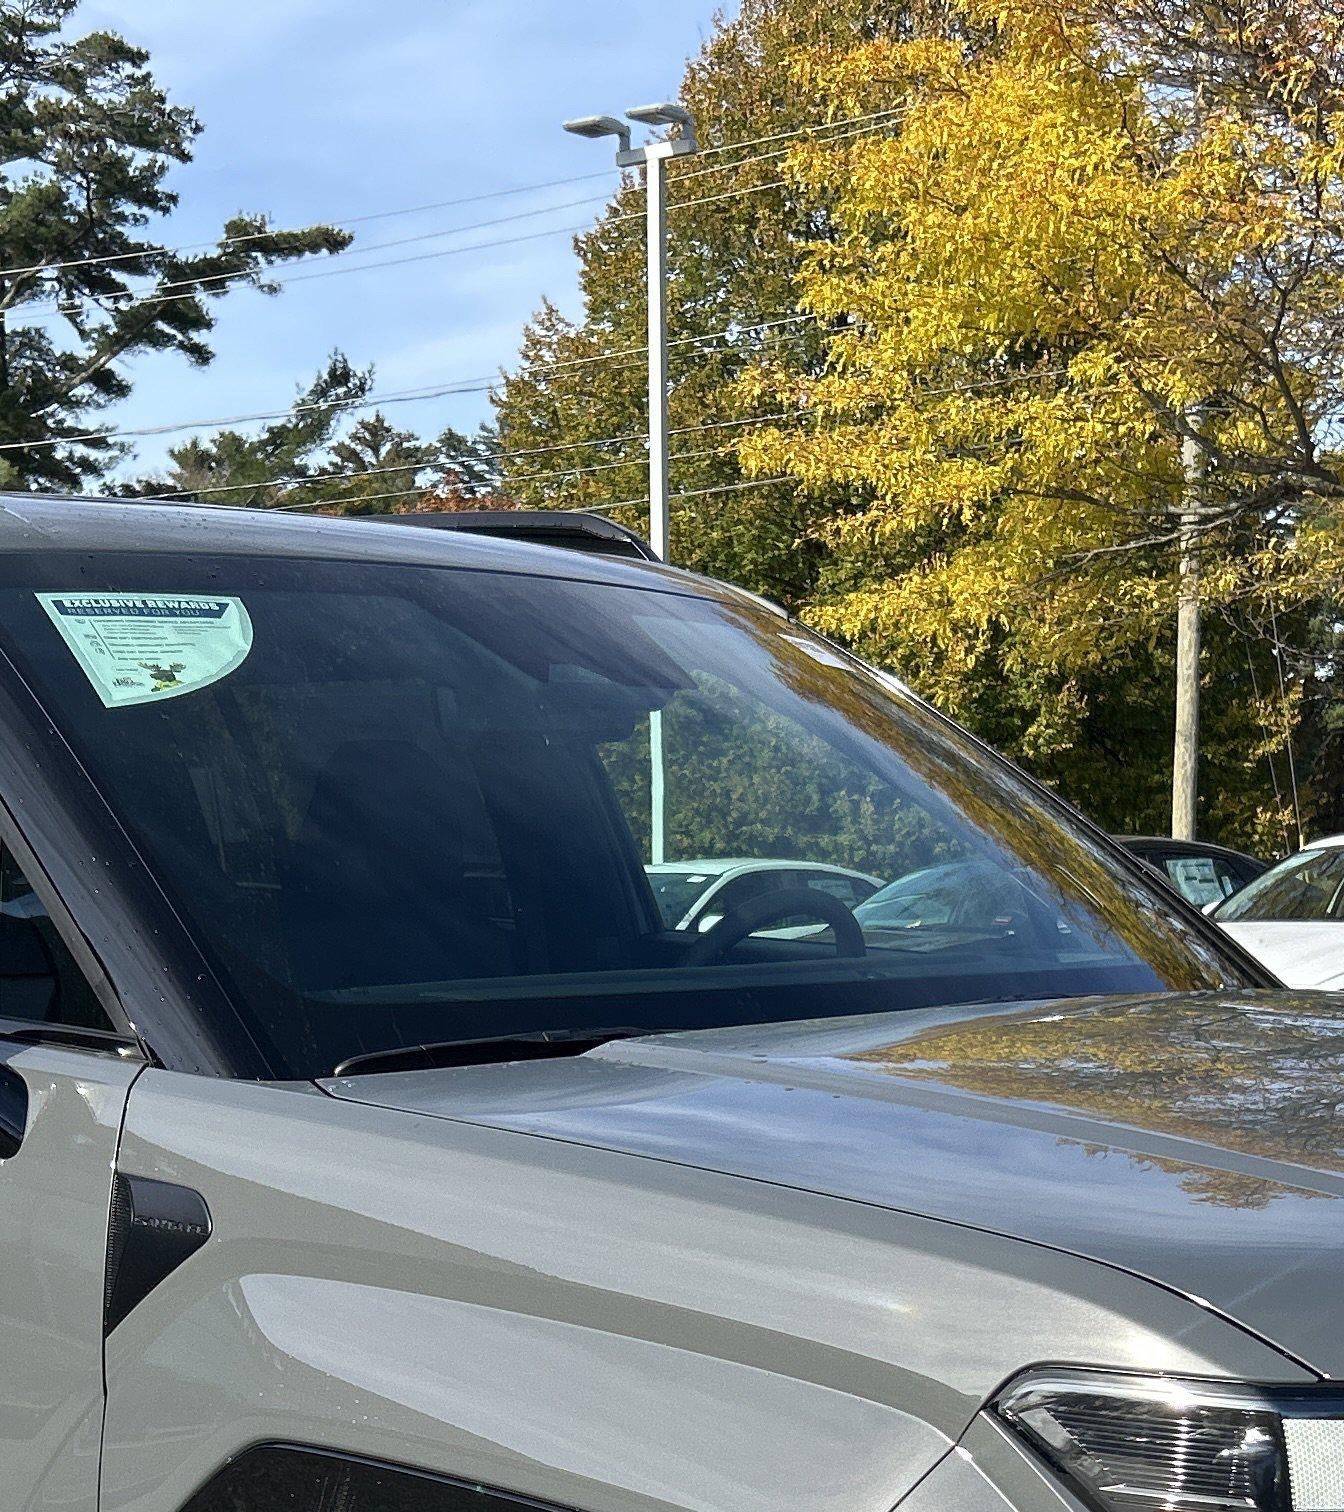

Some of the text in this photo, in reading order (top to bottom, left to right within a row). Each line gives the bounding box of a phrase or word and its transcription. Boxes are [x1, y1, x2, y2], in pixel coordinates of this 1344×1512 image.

[62, 599, 220, 610] EXCLUSIVE REWARDS
[67, 607, 140, 615] RESERVED
[143, 608, 169, 616] FOR
